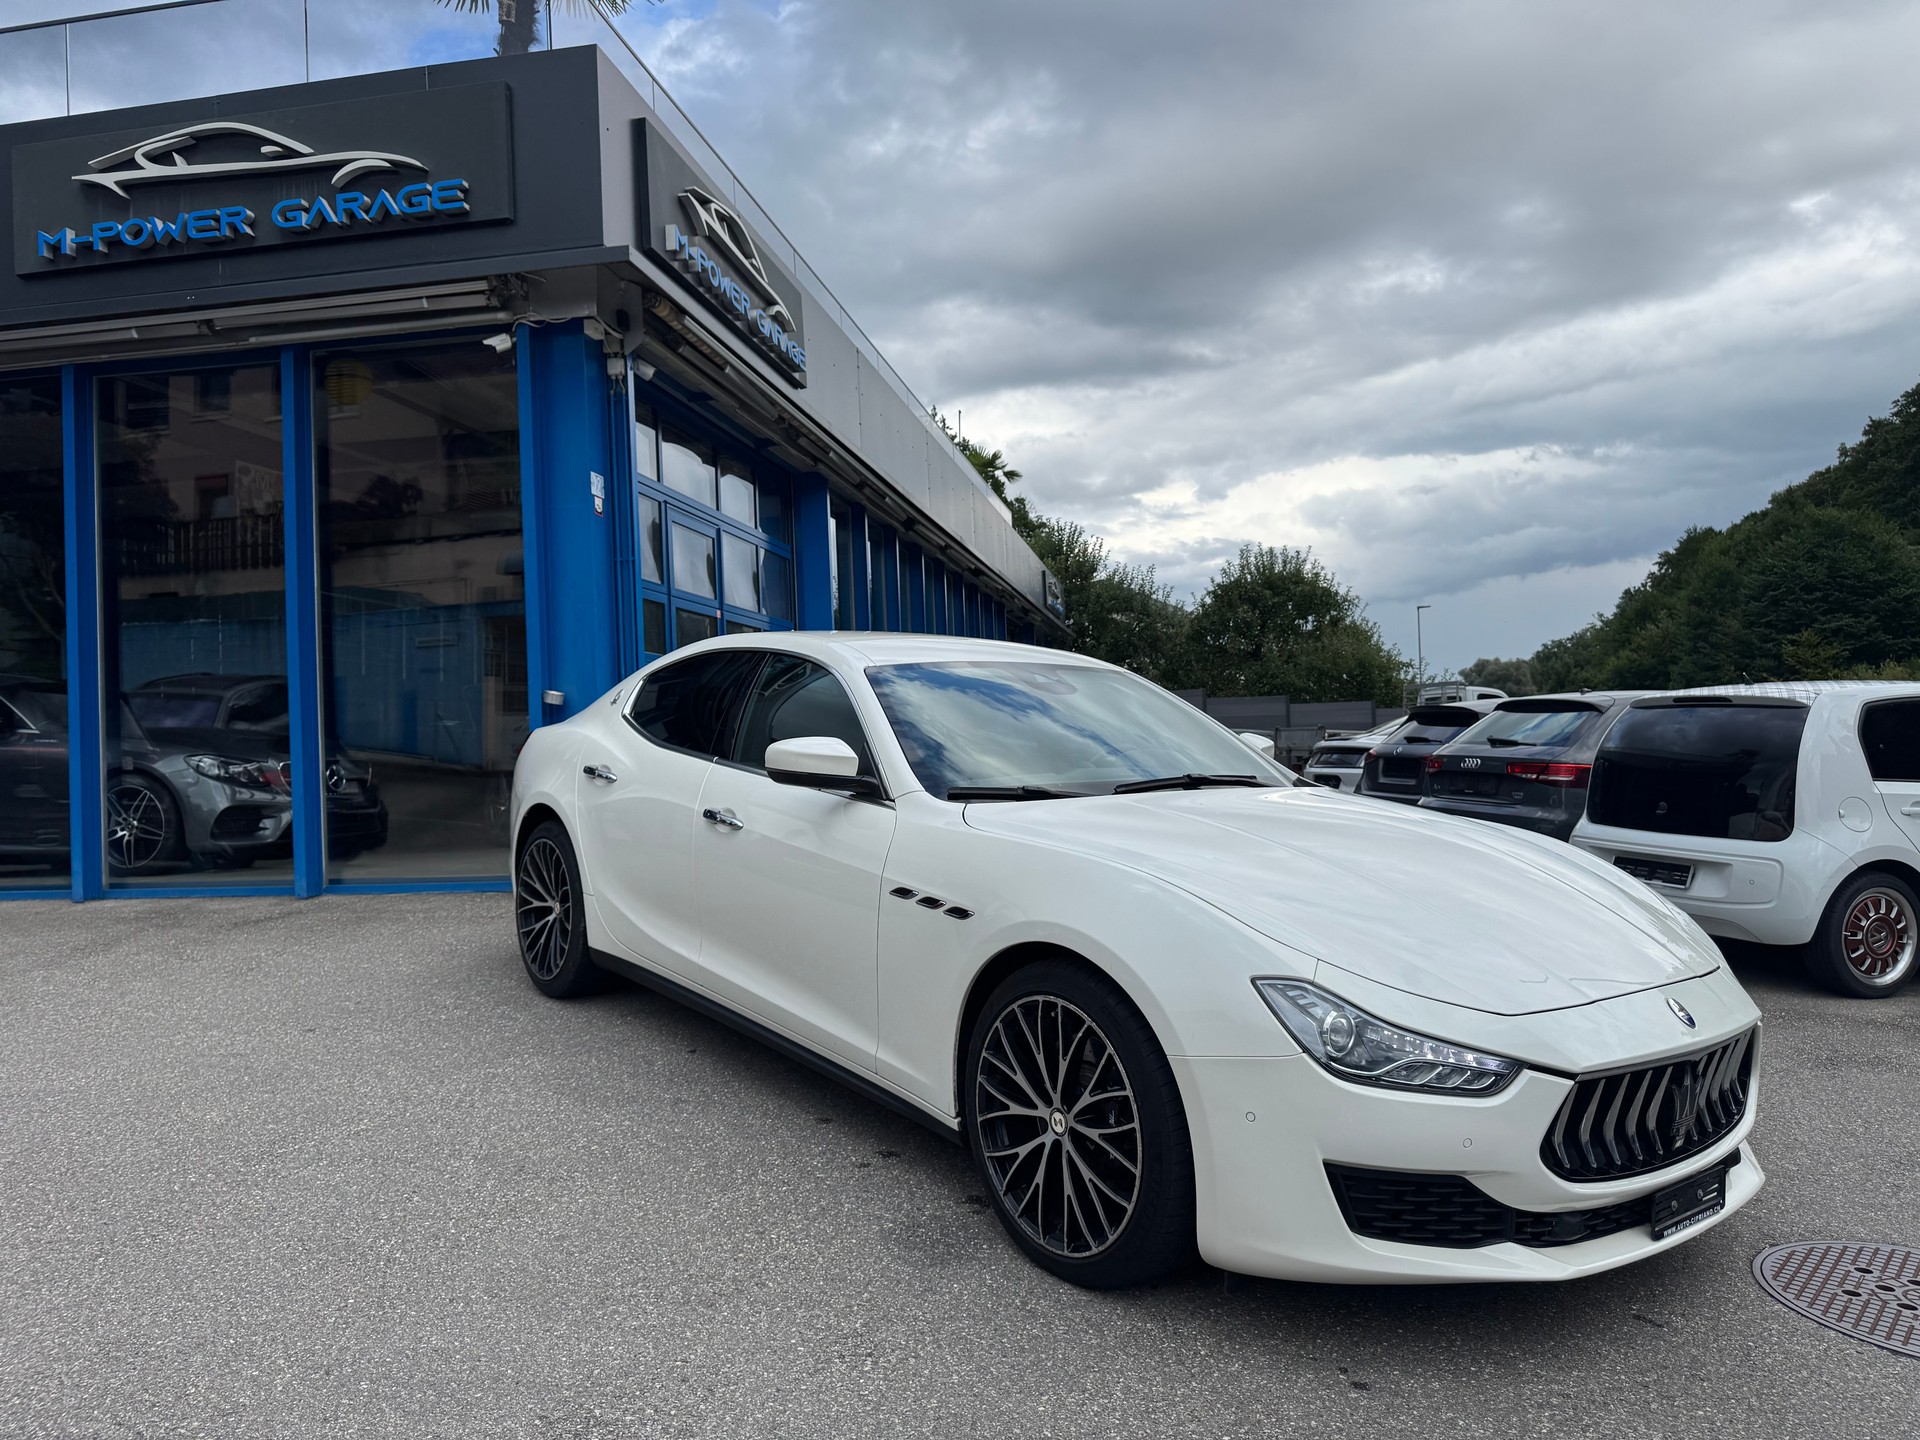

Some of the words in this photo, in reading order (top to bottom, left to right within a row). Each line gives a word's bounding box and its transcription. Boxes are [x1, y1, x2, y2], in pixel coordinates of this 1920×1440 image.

[38, 206, 254, 258] M-POWER
[272, 179, 470, 228] GARAGE
[675, 226, 751, 320] M-POWER
[756, 309, 807, 372] GARAGE
